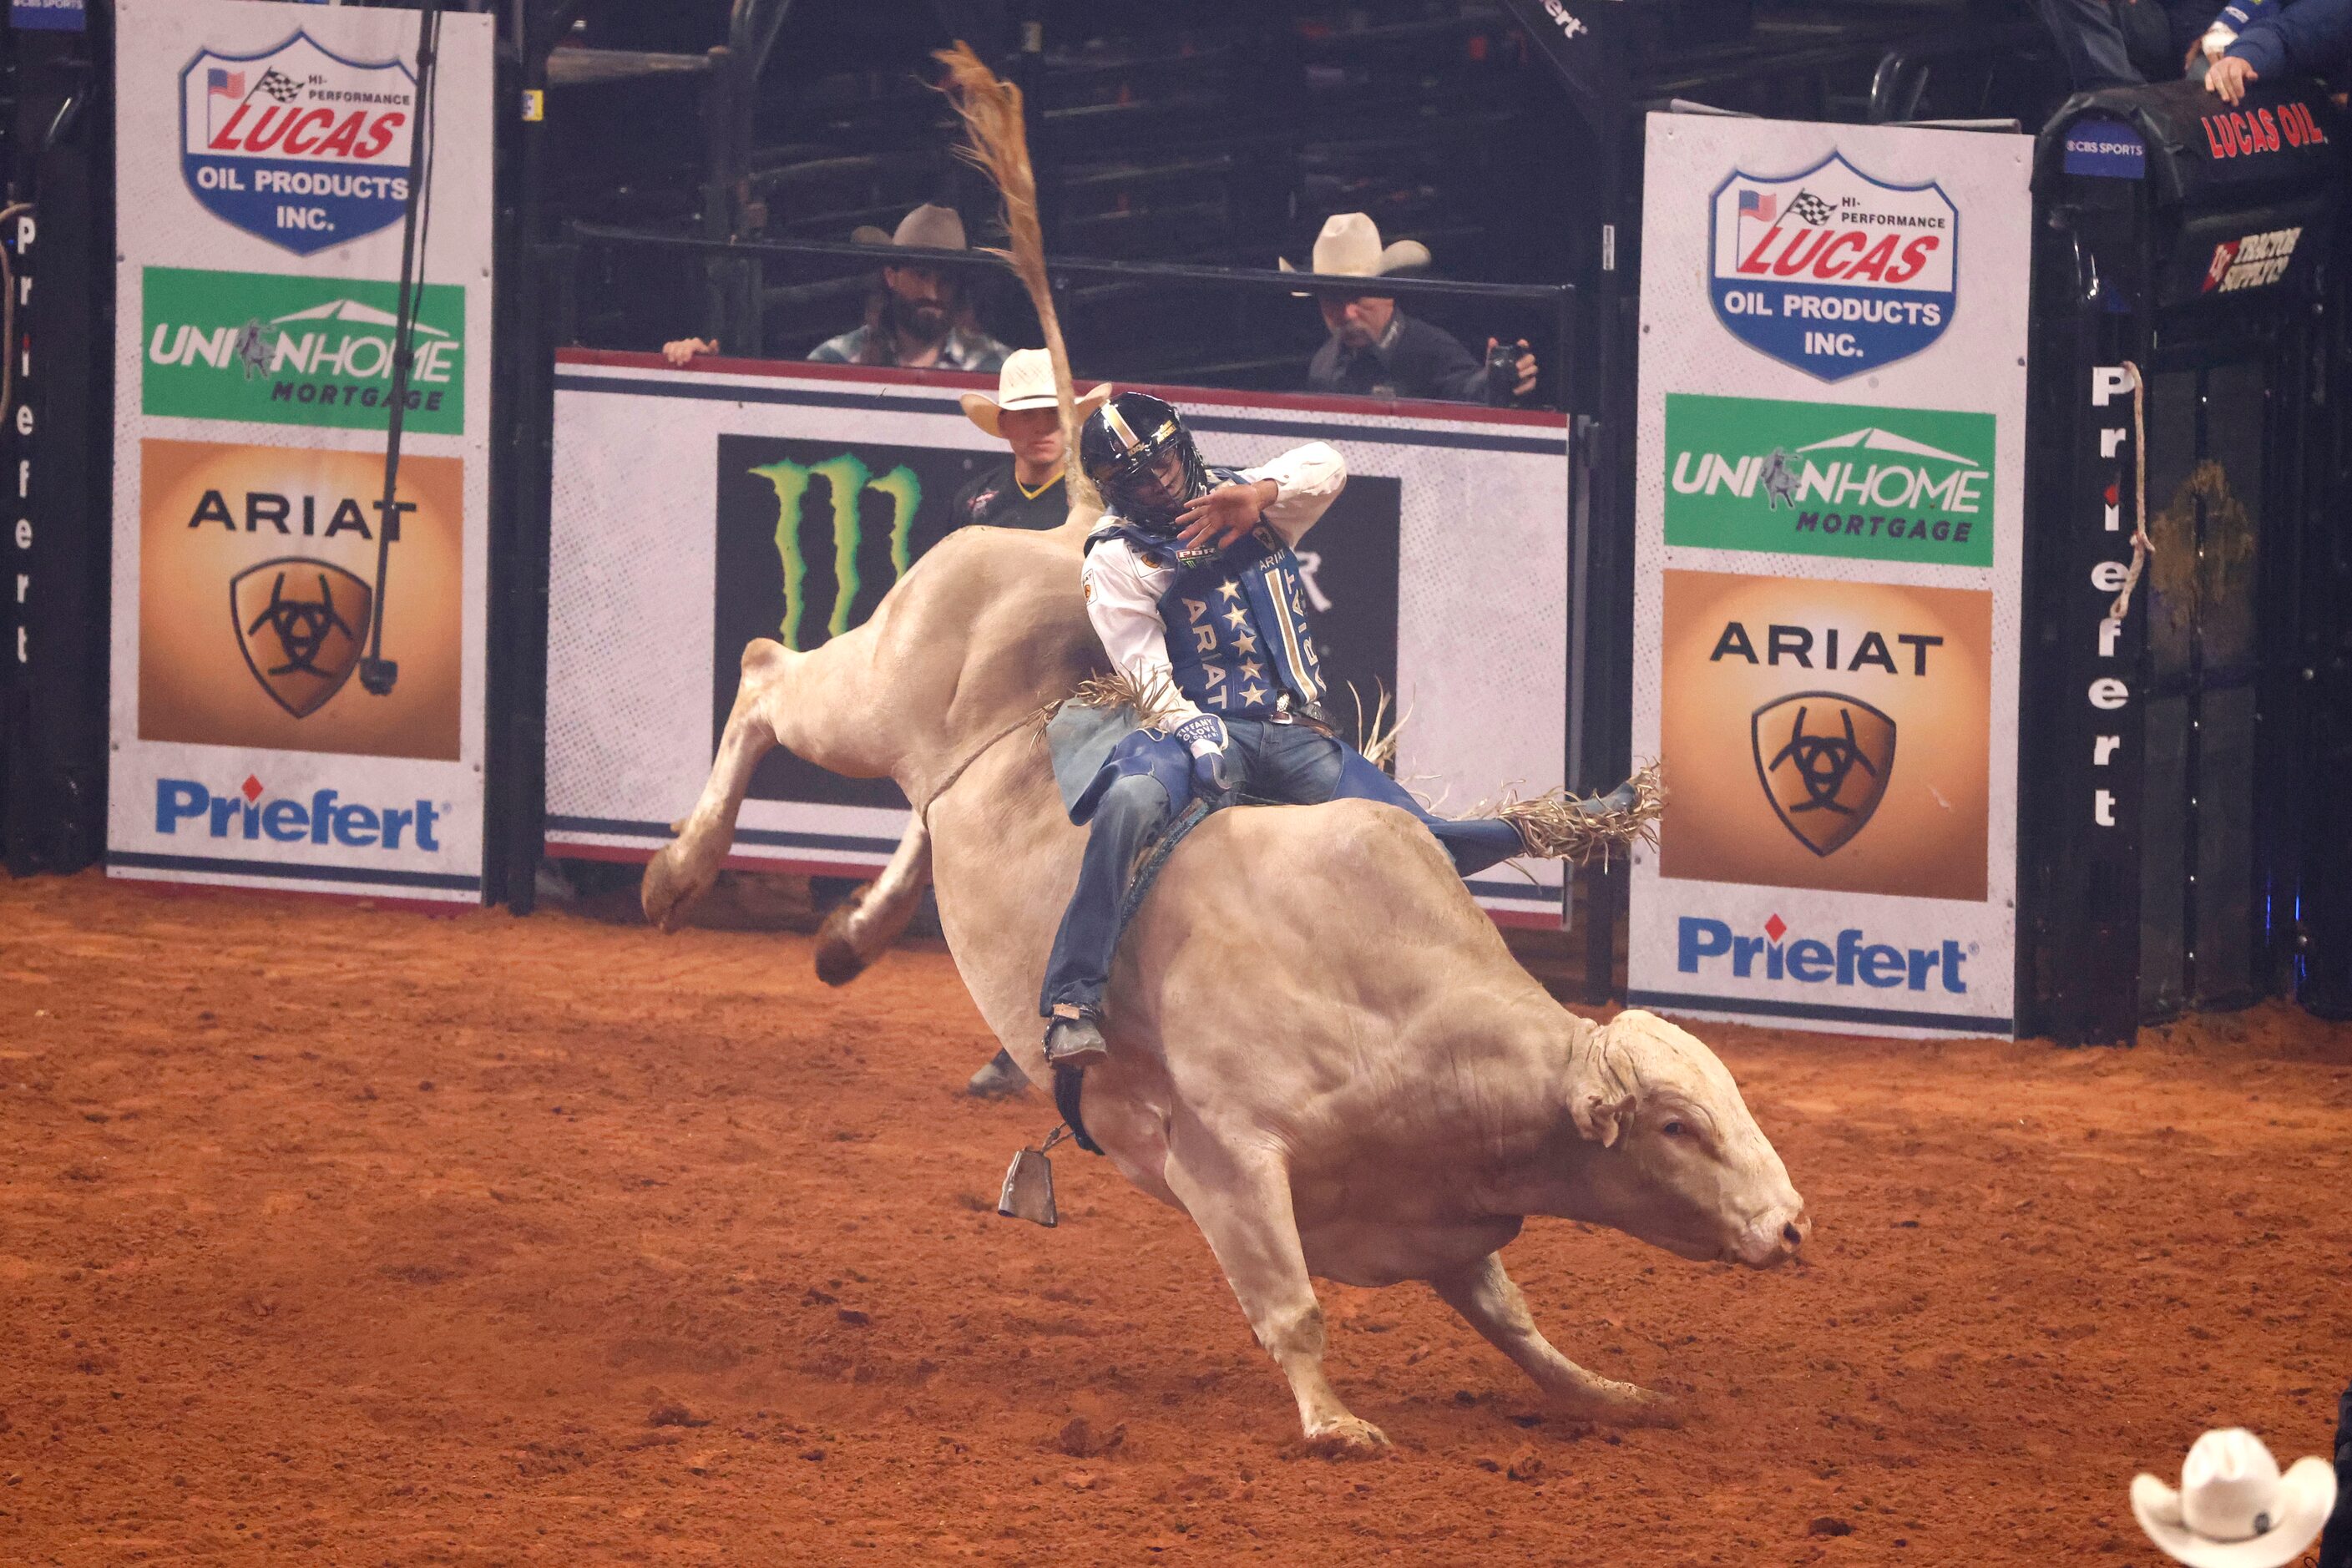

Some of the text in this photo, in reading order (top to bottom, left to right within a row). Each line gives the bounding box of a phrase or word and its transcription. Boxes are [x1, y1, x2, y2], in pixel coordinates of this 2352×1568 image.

[308, 89, 411, 105] PERFORMANCE
[208, 104, 406, 159] LUCAS
[2201, 102, 2324, 159] LUCAS OIL
[2076, 141, 2143, 156] CBS SPORTS
[197, 166, 408, 200] OIL PRODUCTS
[1841, 197, 1861, 207] HI-
[276, 206, 335, 231] INC.
[1841, 212, 1945, 229] PERFORMANCE
[1737, 226, 1940, 284] LUCAS
[1724, 291, 1941, 326] OIL PRODUCTS
[1804, 331, 1864, 357] INC.
[1672, 450, 1990, 514] UNINHOME
[188, 489, 417, 542] ARIAT
[1796, 511, 1974, 543] MORTGAGE
[1179, 548, 1215, 559] PBR
[1259, 548, 1287, 571] ARIAT
[1180, 597, 1229, 710] ARIAT
[1709, 621, 1944, 676] ARIAT
[1176, 718, 1213, 739] TIFFANY
[1182, 726, 1217, 741] GLOVE
